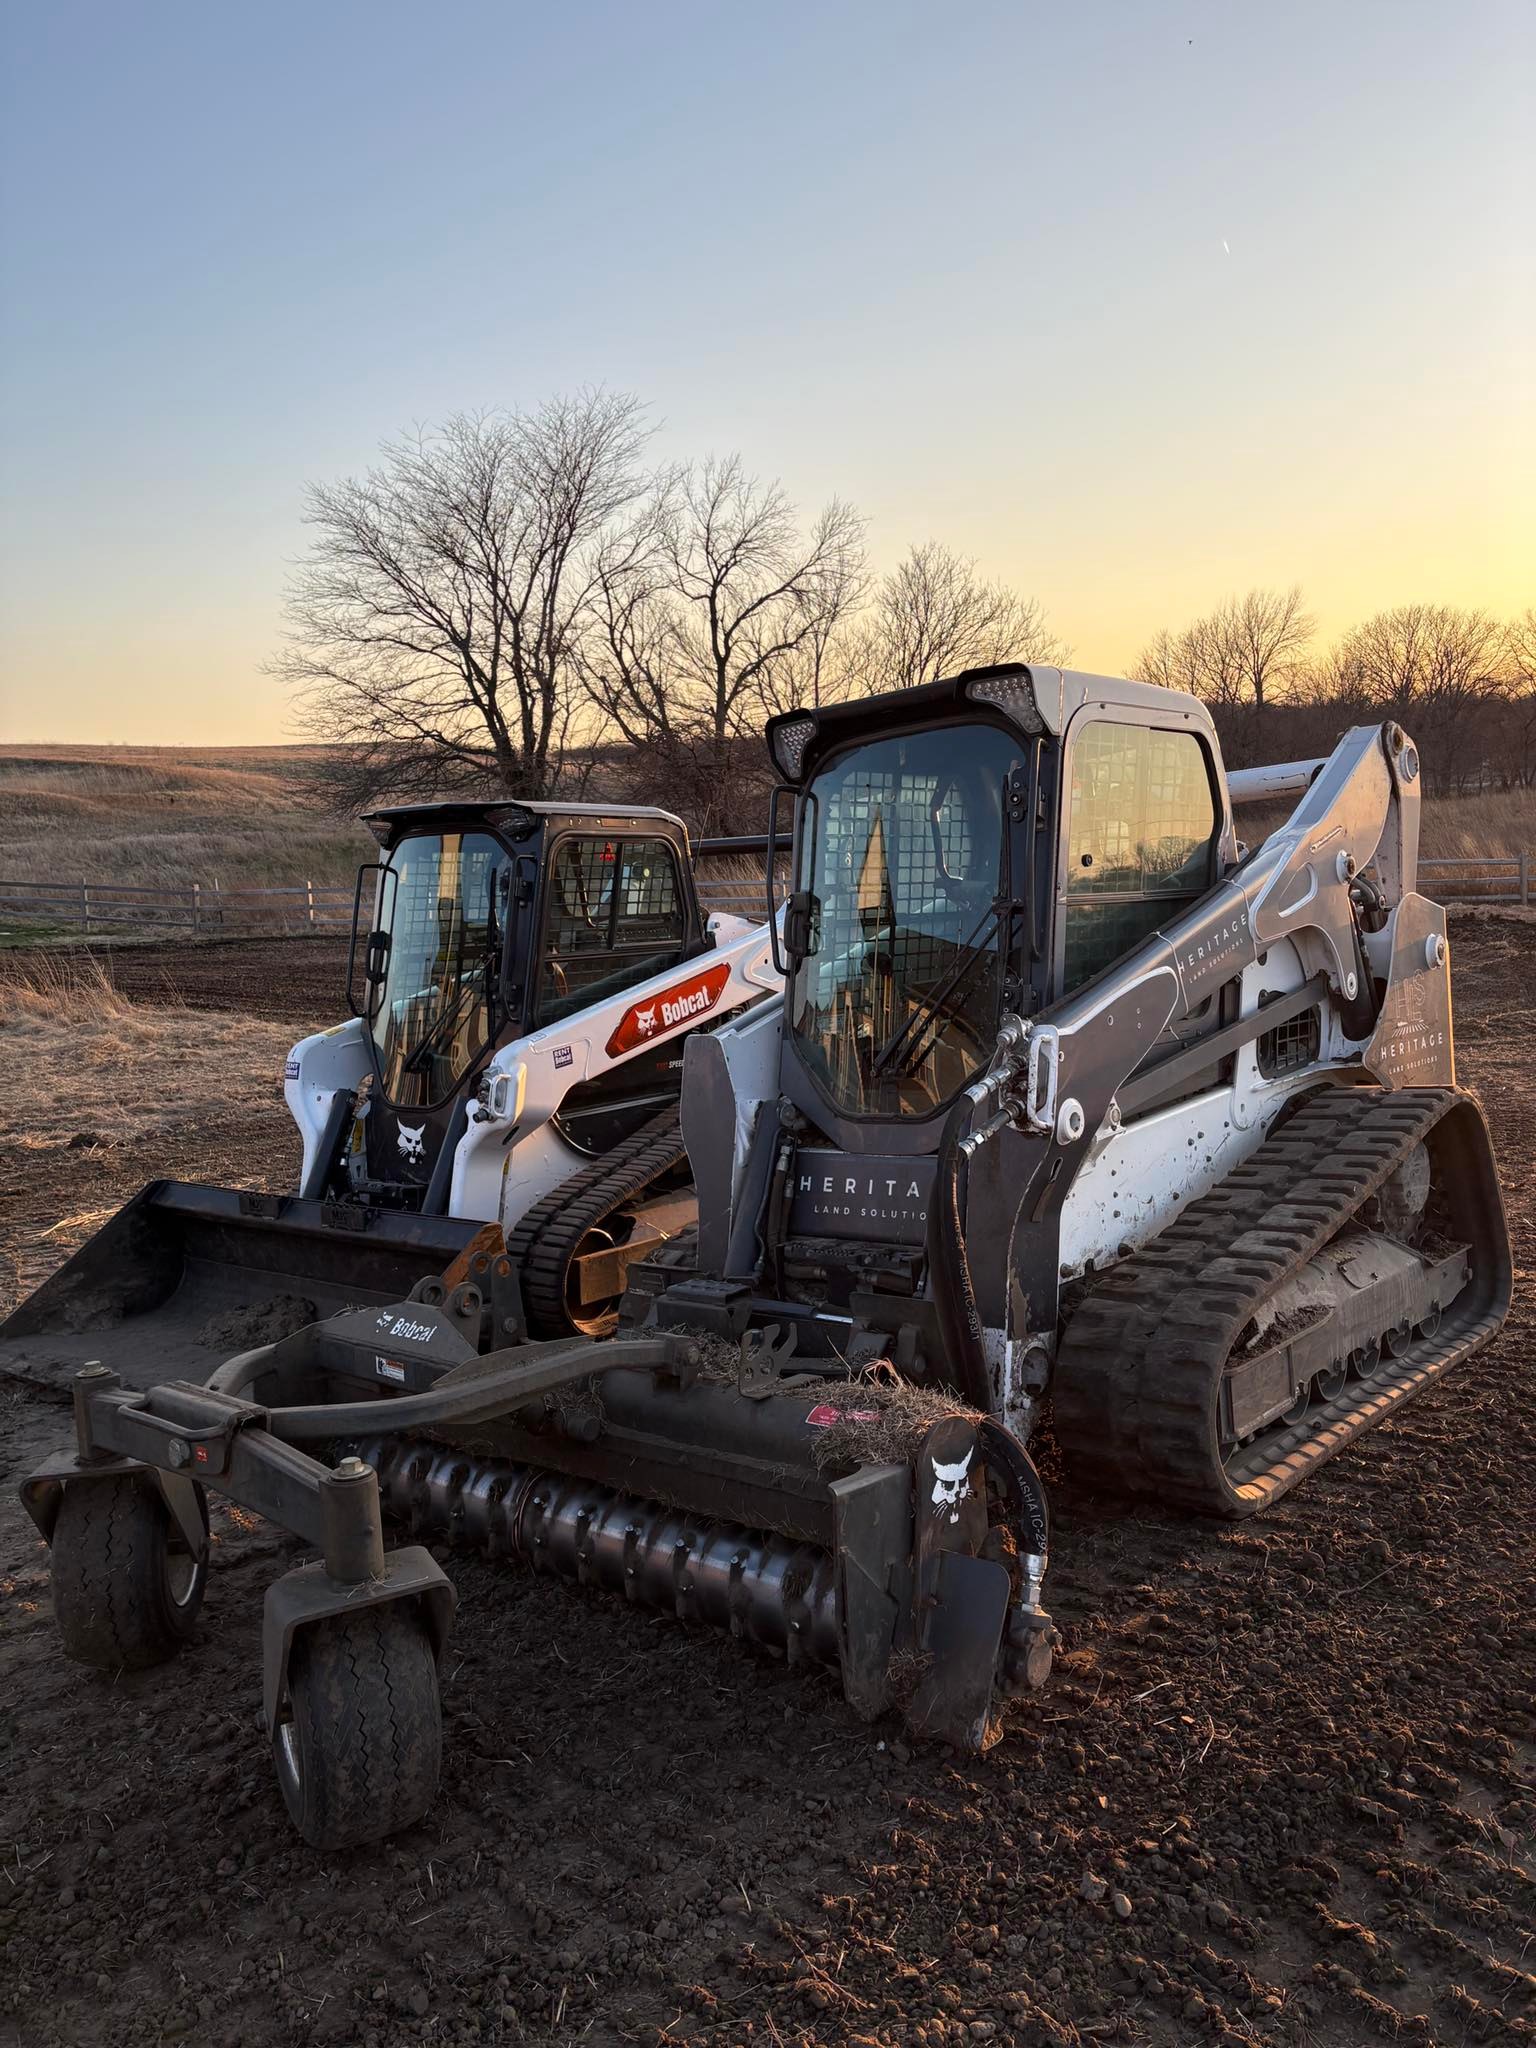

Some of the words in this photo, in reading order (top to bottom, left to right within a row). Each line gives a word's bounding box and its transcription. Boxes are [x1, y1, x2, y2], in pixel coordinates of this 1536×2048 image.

[1178, 914, 1247, 972] HERITAGE
[661, 985, 710, 1026] Bobcat
[1381, 1032, 1443, 1060] HERITAGE
[1389, 1065, 1404, 1075] LAND
[1407, 1055, 1438, 1070] SOLUTIONS
[800, 1176, 920, 1198] HERITA
[814, 1205, 850, 1215] LAND
[861, 1208, 927, 1220] SOLUTIO
[390, 1318, 438, 1342] Bobcat
[1017, 1475, 1038, 1512] MSHA
